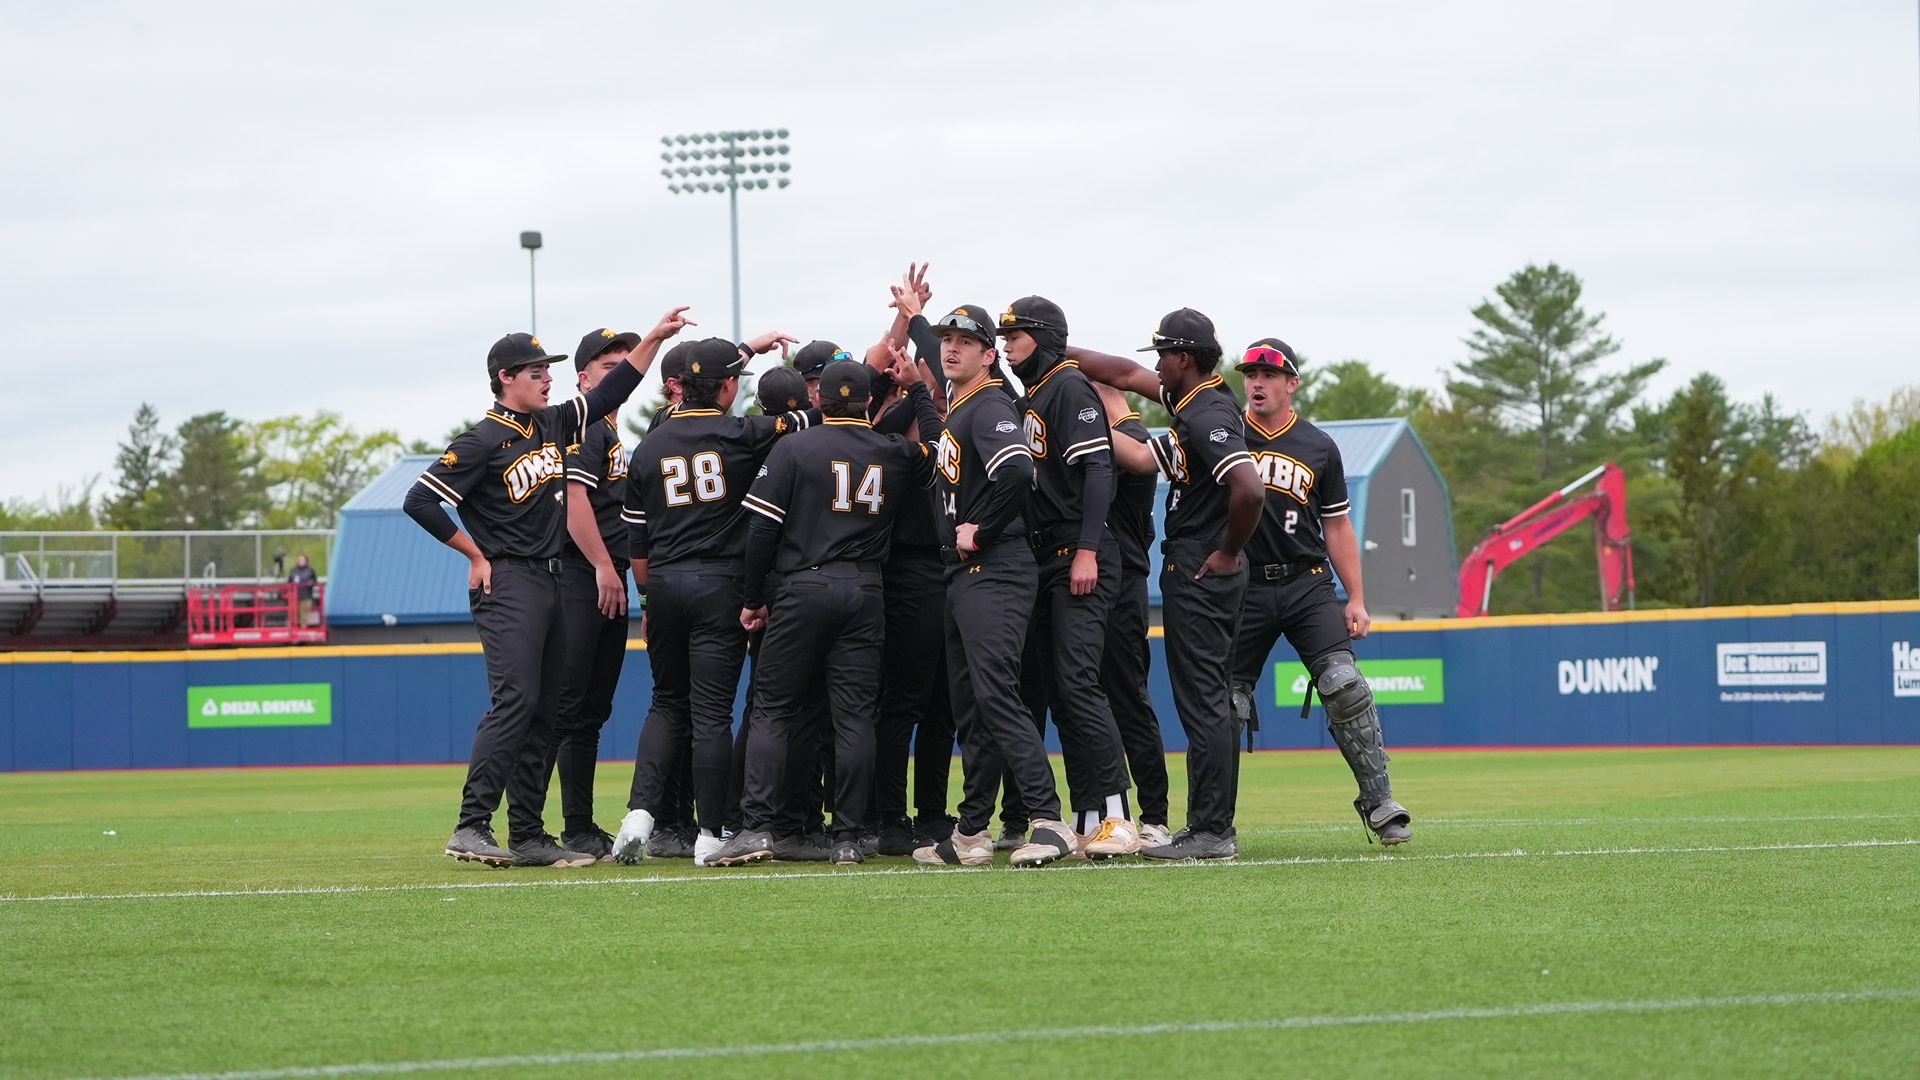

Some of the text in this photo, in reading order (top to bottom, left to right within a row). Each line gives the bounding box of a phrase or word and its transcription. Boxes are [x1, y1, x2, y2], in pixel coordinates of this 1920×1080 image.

[661, 452, 727, 508] 28
[831, 461, 885, 515] 14
[1249, 452, 1315, 504] MBC
[1284, 510, 1299, 534] 2
[1368, 676, 1424, 692] DENTAL
[1558, 656, 1659, 695] DUNKIN'
[220, 699, 315, 715] DELTA DENTAL
